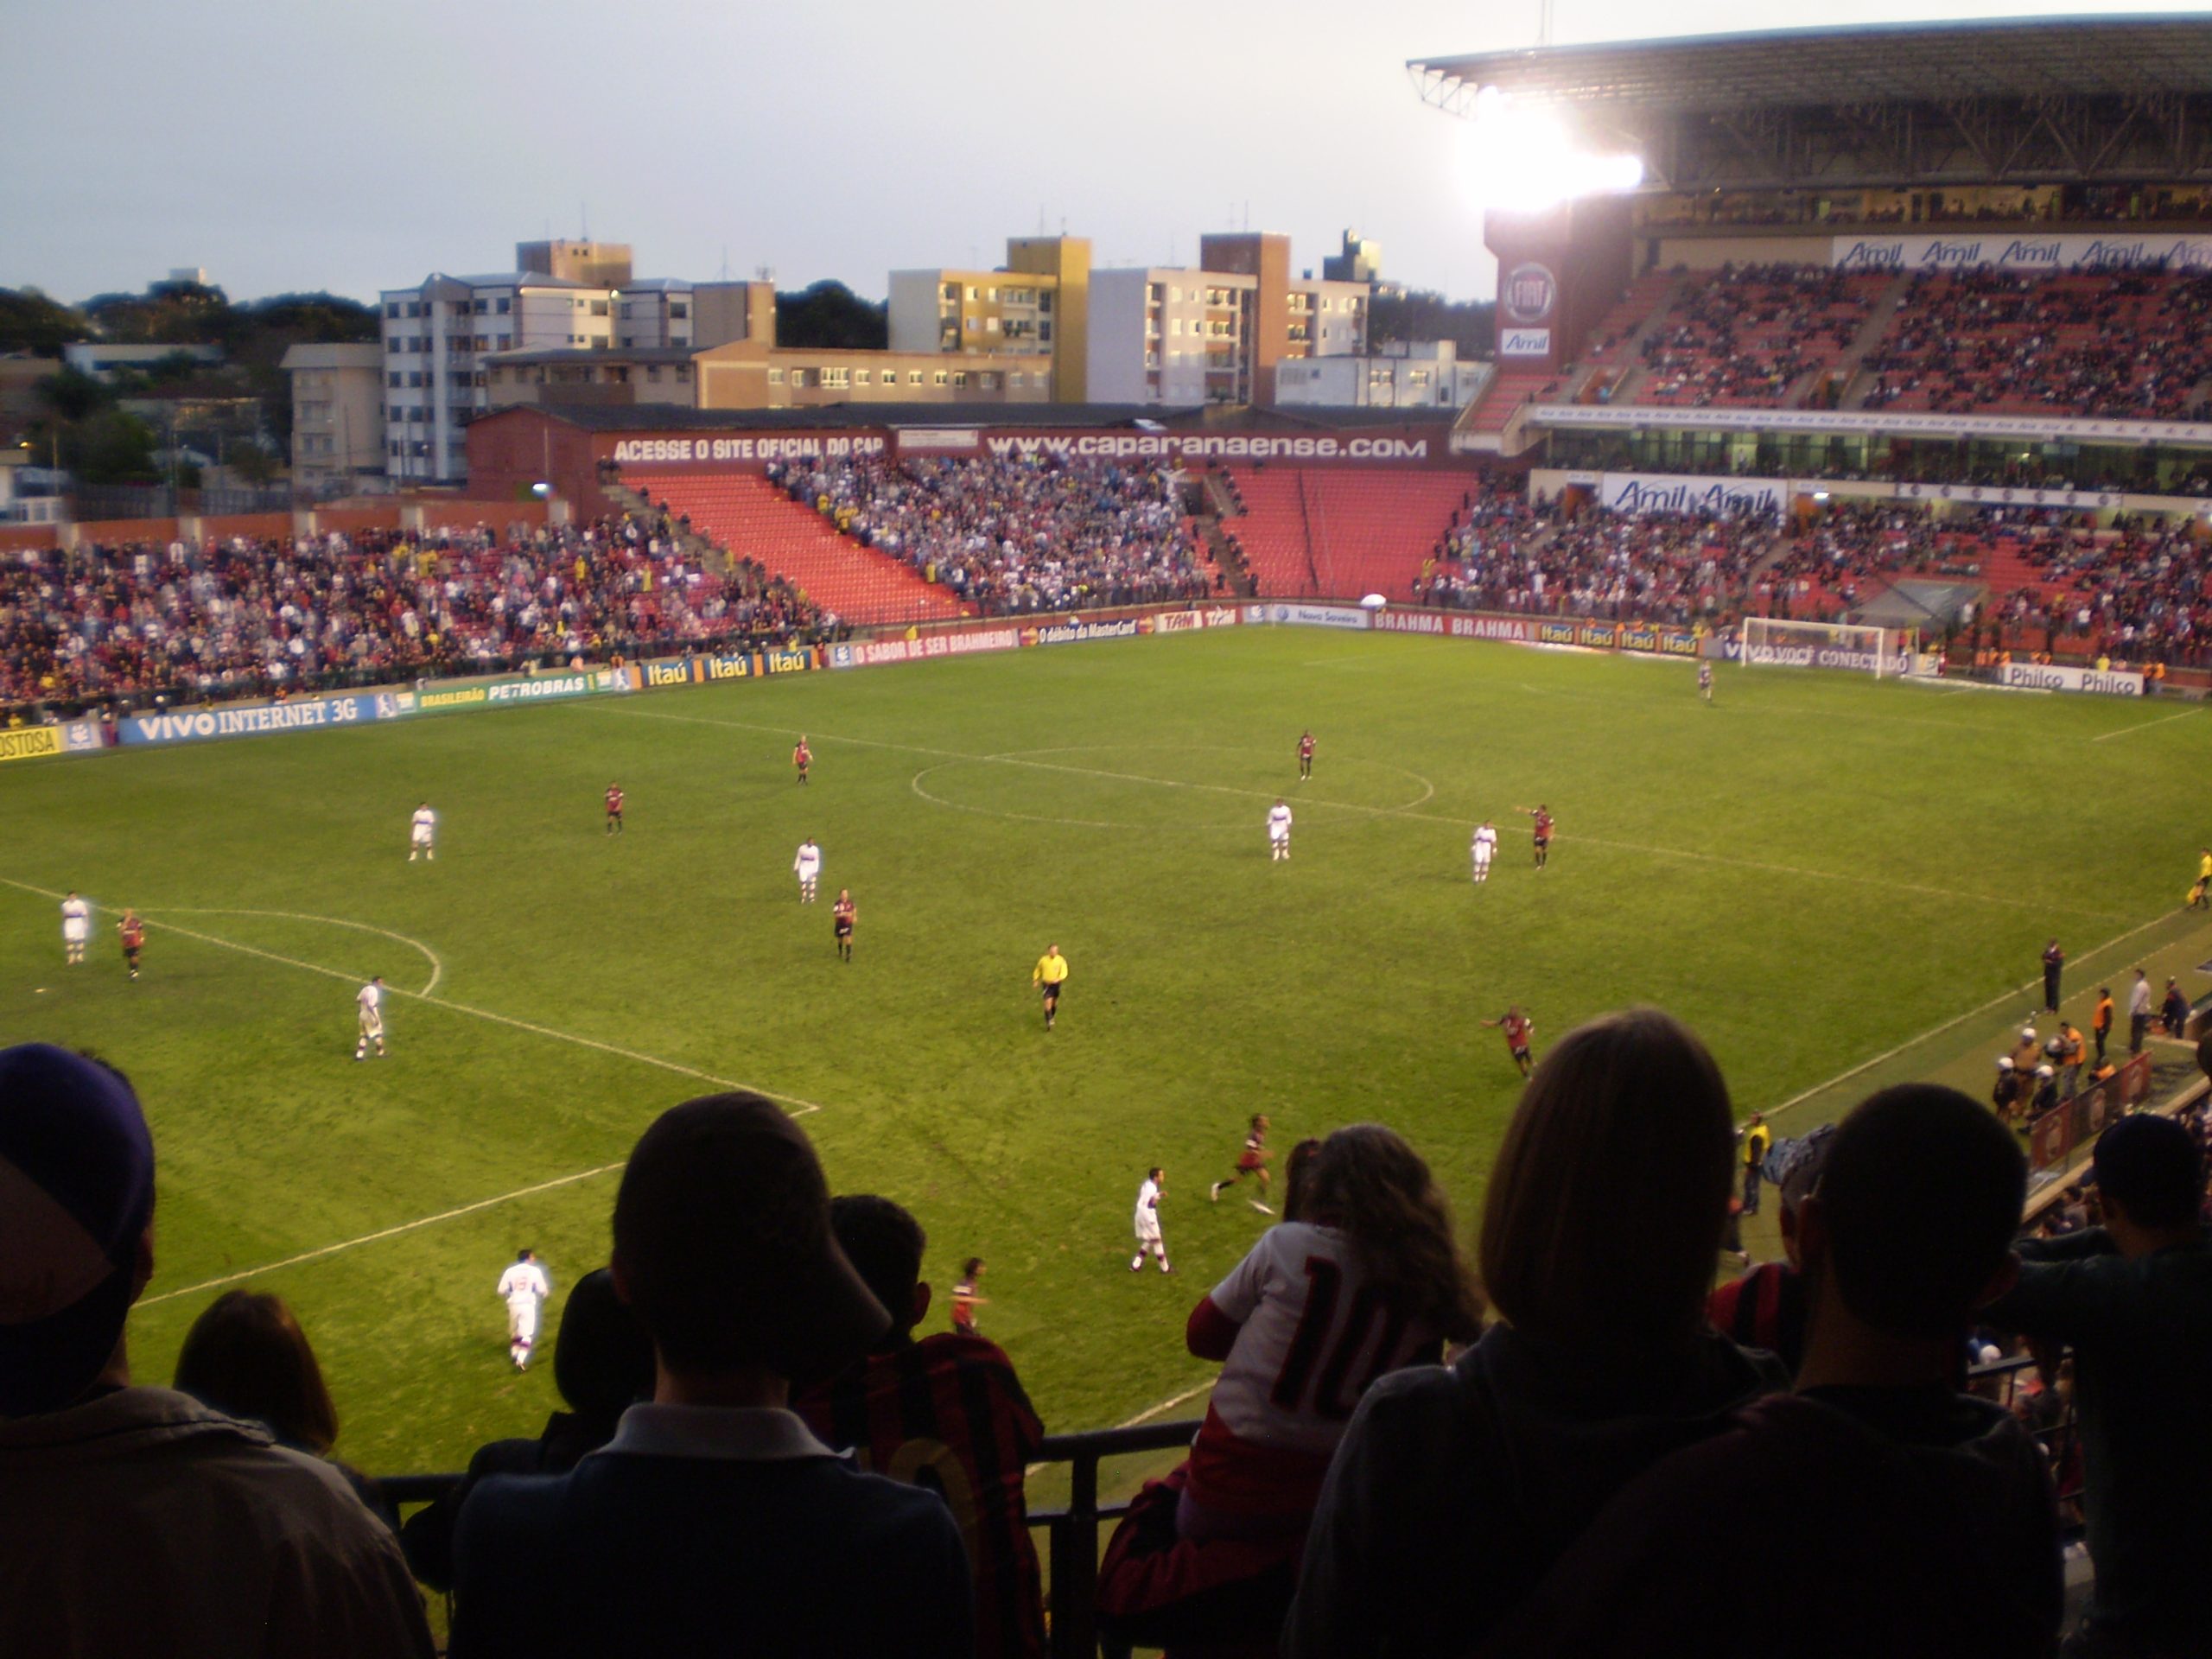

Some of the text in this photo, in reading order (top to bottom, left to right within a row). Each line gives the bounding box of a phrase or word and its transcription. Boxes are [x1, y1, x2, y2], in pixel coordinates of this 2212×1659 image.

[1846, 241, 1903, 263] Amil
[1921, 241, 1982, 262] Amil
[1999, 240, 2062, 263] Amil
[2082, 240, 2144, 263] Amil
[1506, 334, 1548, 350] Amil
[614, 440, 691, 461] ACESSE
[696, 439, 709, 460] O
[713, 439, 753, 459] SITE
[757, 437, 821, 458] OFICIAL
[826, 437, 849, 456] DO
[854, 436, 883, 455] CAP
[1615, 480, 1774, 512] Amil Amil
[1089, 619, 1138, 638] MasterCard
[1166, 614, 1195, 628] TAM
[1375, 613, 1525, 639] BRAHMA BRAHMA
[855, 628, 1014, 663] O SABOR DE SER BRAHMEIRO
[1541, 625, 1697, 652] Itaú Itaú Itaú Itaú
[648, 652, 804, 685] Itaú Itaú Itaú
[2012, 667, 2136, 695] Philco Philco
[421, 687, 485, 707] BRASILEIRÃO
[488, 676, 584, 701] PETROBRAS
[138, 698, 359, 741] VIVO INTERNET 3G
[1269, 1255, 1410, 1418] 10
